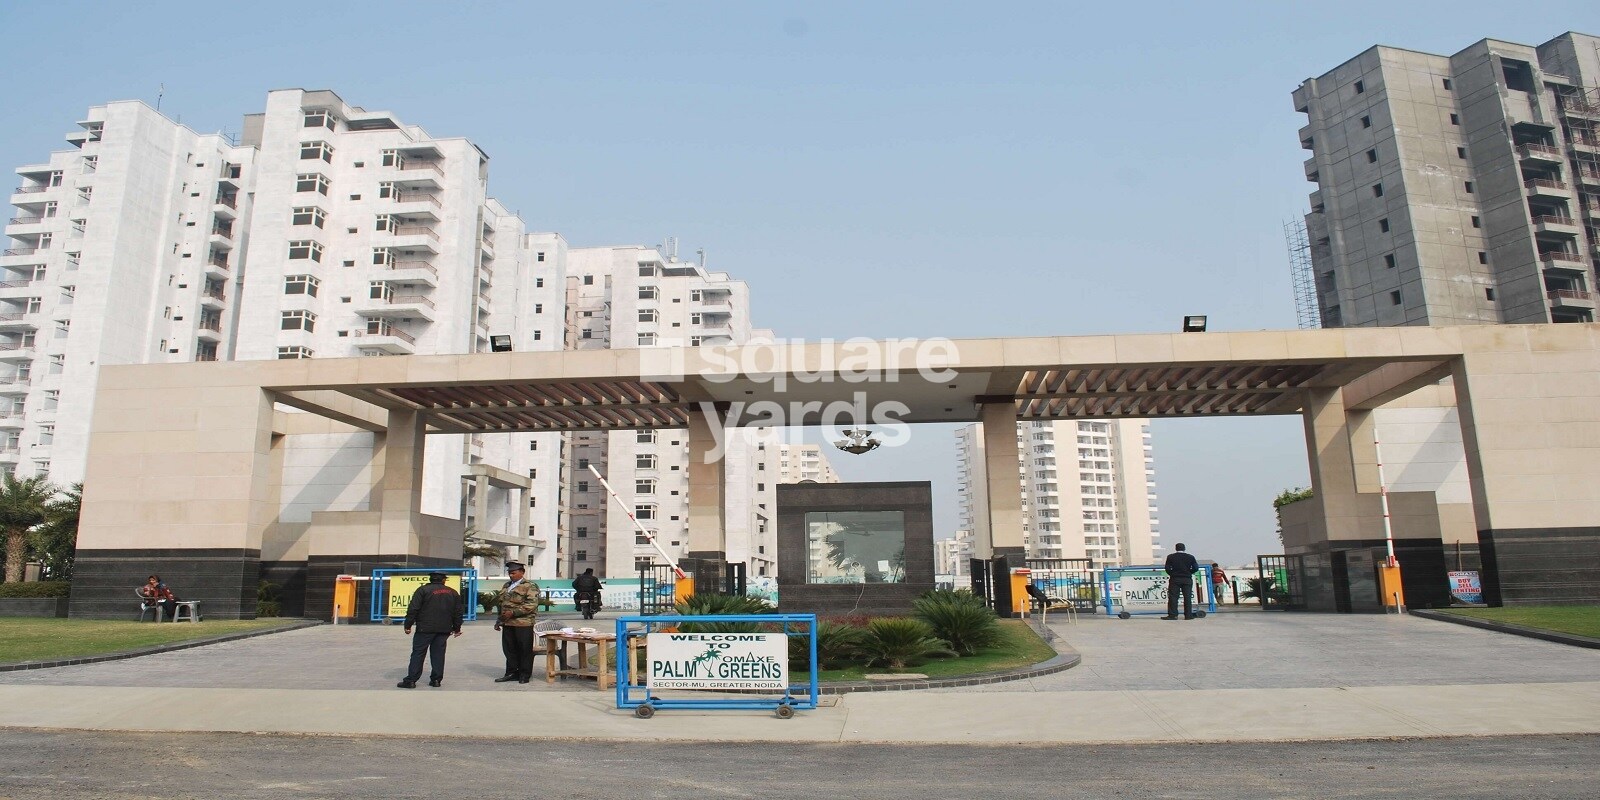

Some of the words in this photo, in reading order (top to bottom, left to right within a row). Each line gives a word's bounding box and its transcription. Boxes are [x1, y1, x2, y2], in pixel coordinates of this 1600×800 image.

[1125, 590, 1150, 600] PALM
[722, 651, 775, 663] OMAXE
[653, 660, 697, 678] PALM
[718, 662, 782, 679] GREENS
[653, 681, 708, 689] SECTOR-MU,
